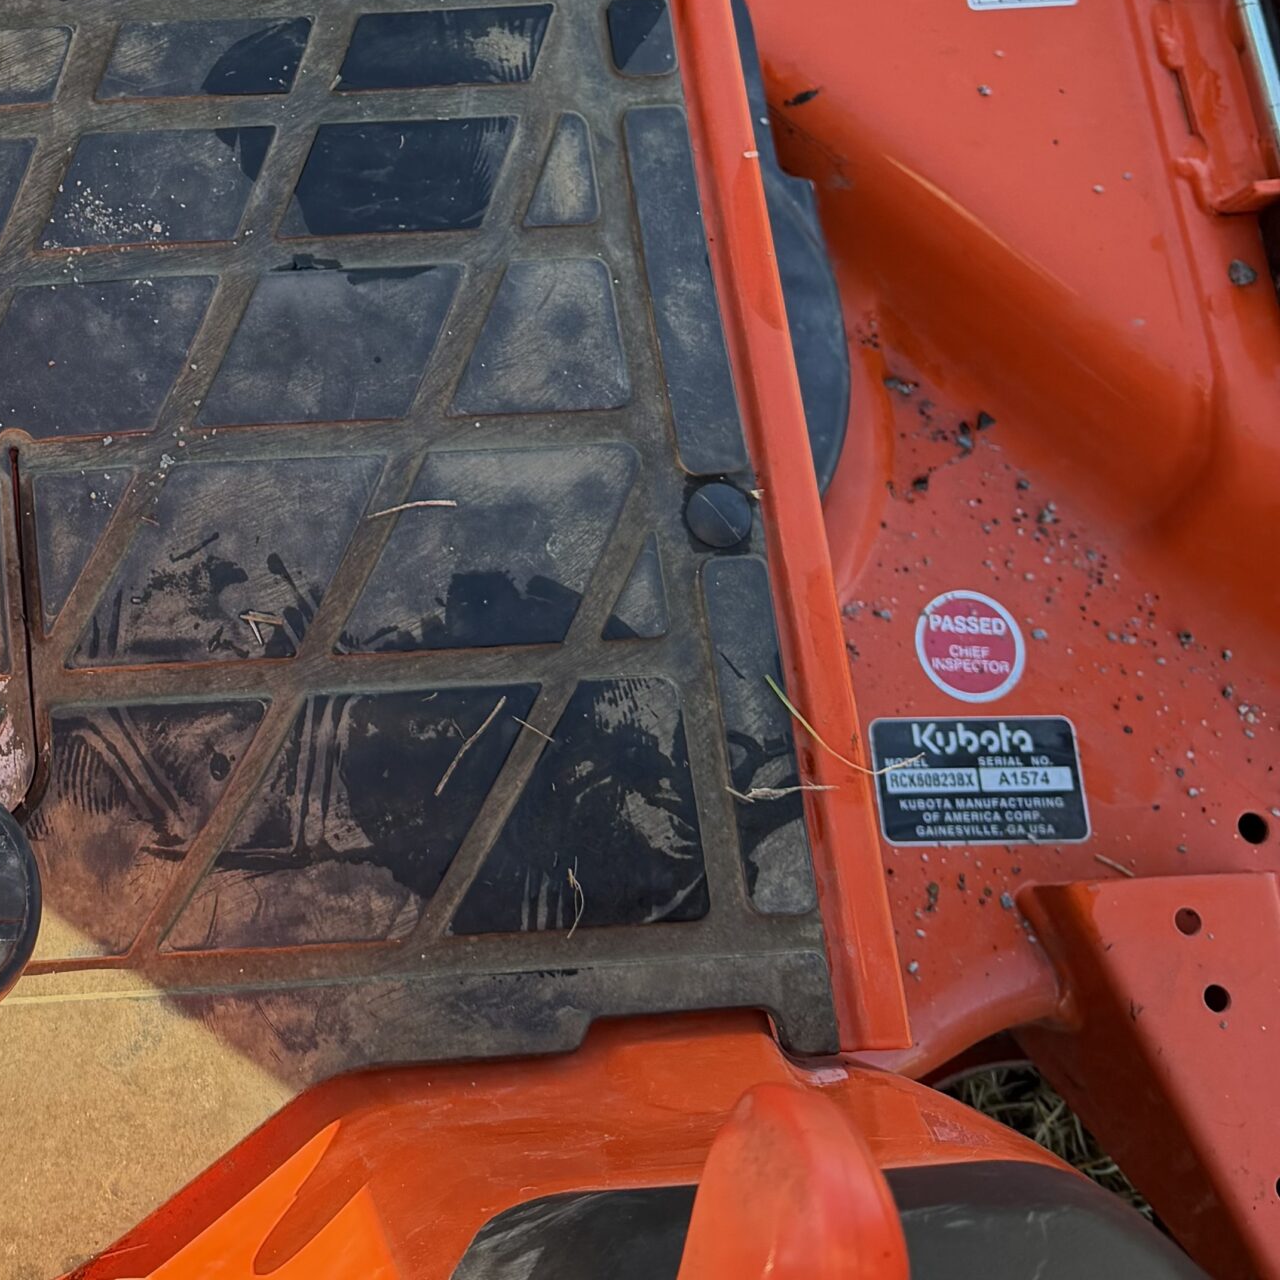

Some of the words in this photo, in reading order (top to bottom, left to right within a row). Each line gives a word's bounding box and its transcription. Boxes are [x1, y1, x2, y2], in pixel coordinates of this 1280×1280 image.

[929, 614, 1007, 636] PASSED
[949, 644, 990, 658] CHIEF
[931, 657, 1010, 675] INSPECTOR
[911, 722, 1034, 755] Kubota
[978, 756, 1023, 767] SERIAL
[1031, 755, 1054, 766] NO.
[998, 771, 1050, 786] A1574
[899, 799, 952, 810] KUBOTA
[955, 797, 1064, 810] MANUFACTURING
[922, 812, 940, 823] OF
[944, 811, 1002, 823] AMERICA
[1005, 810, 1045, 822] CORP.
[1029, 824, 1055, 835] USA
